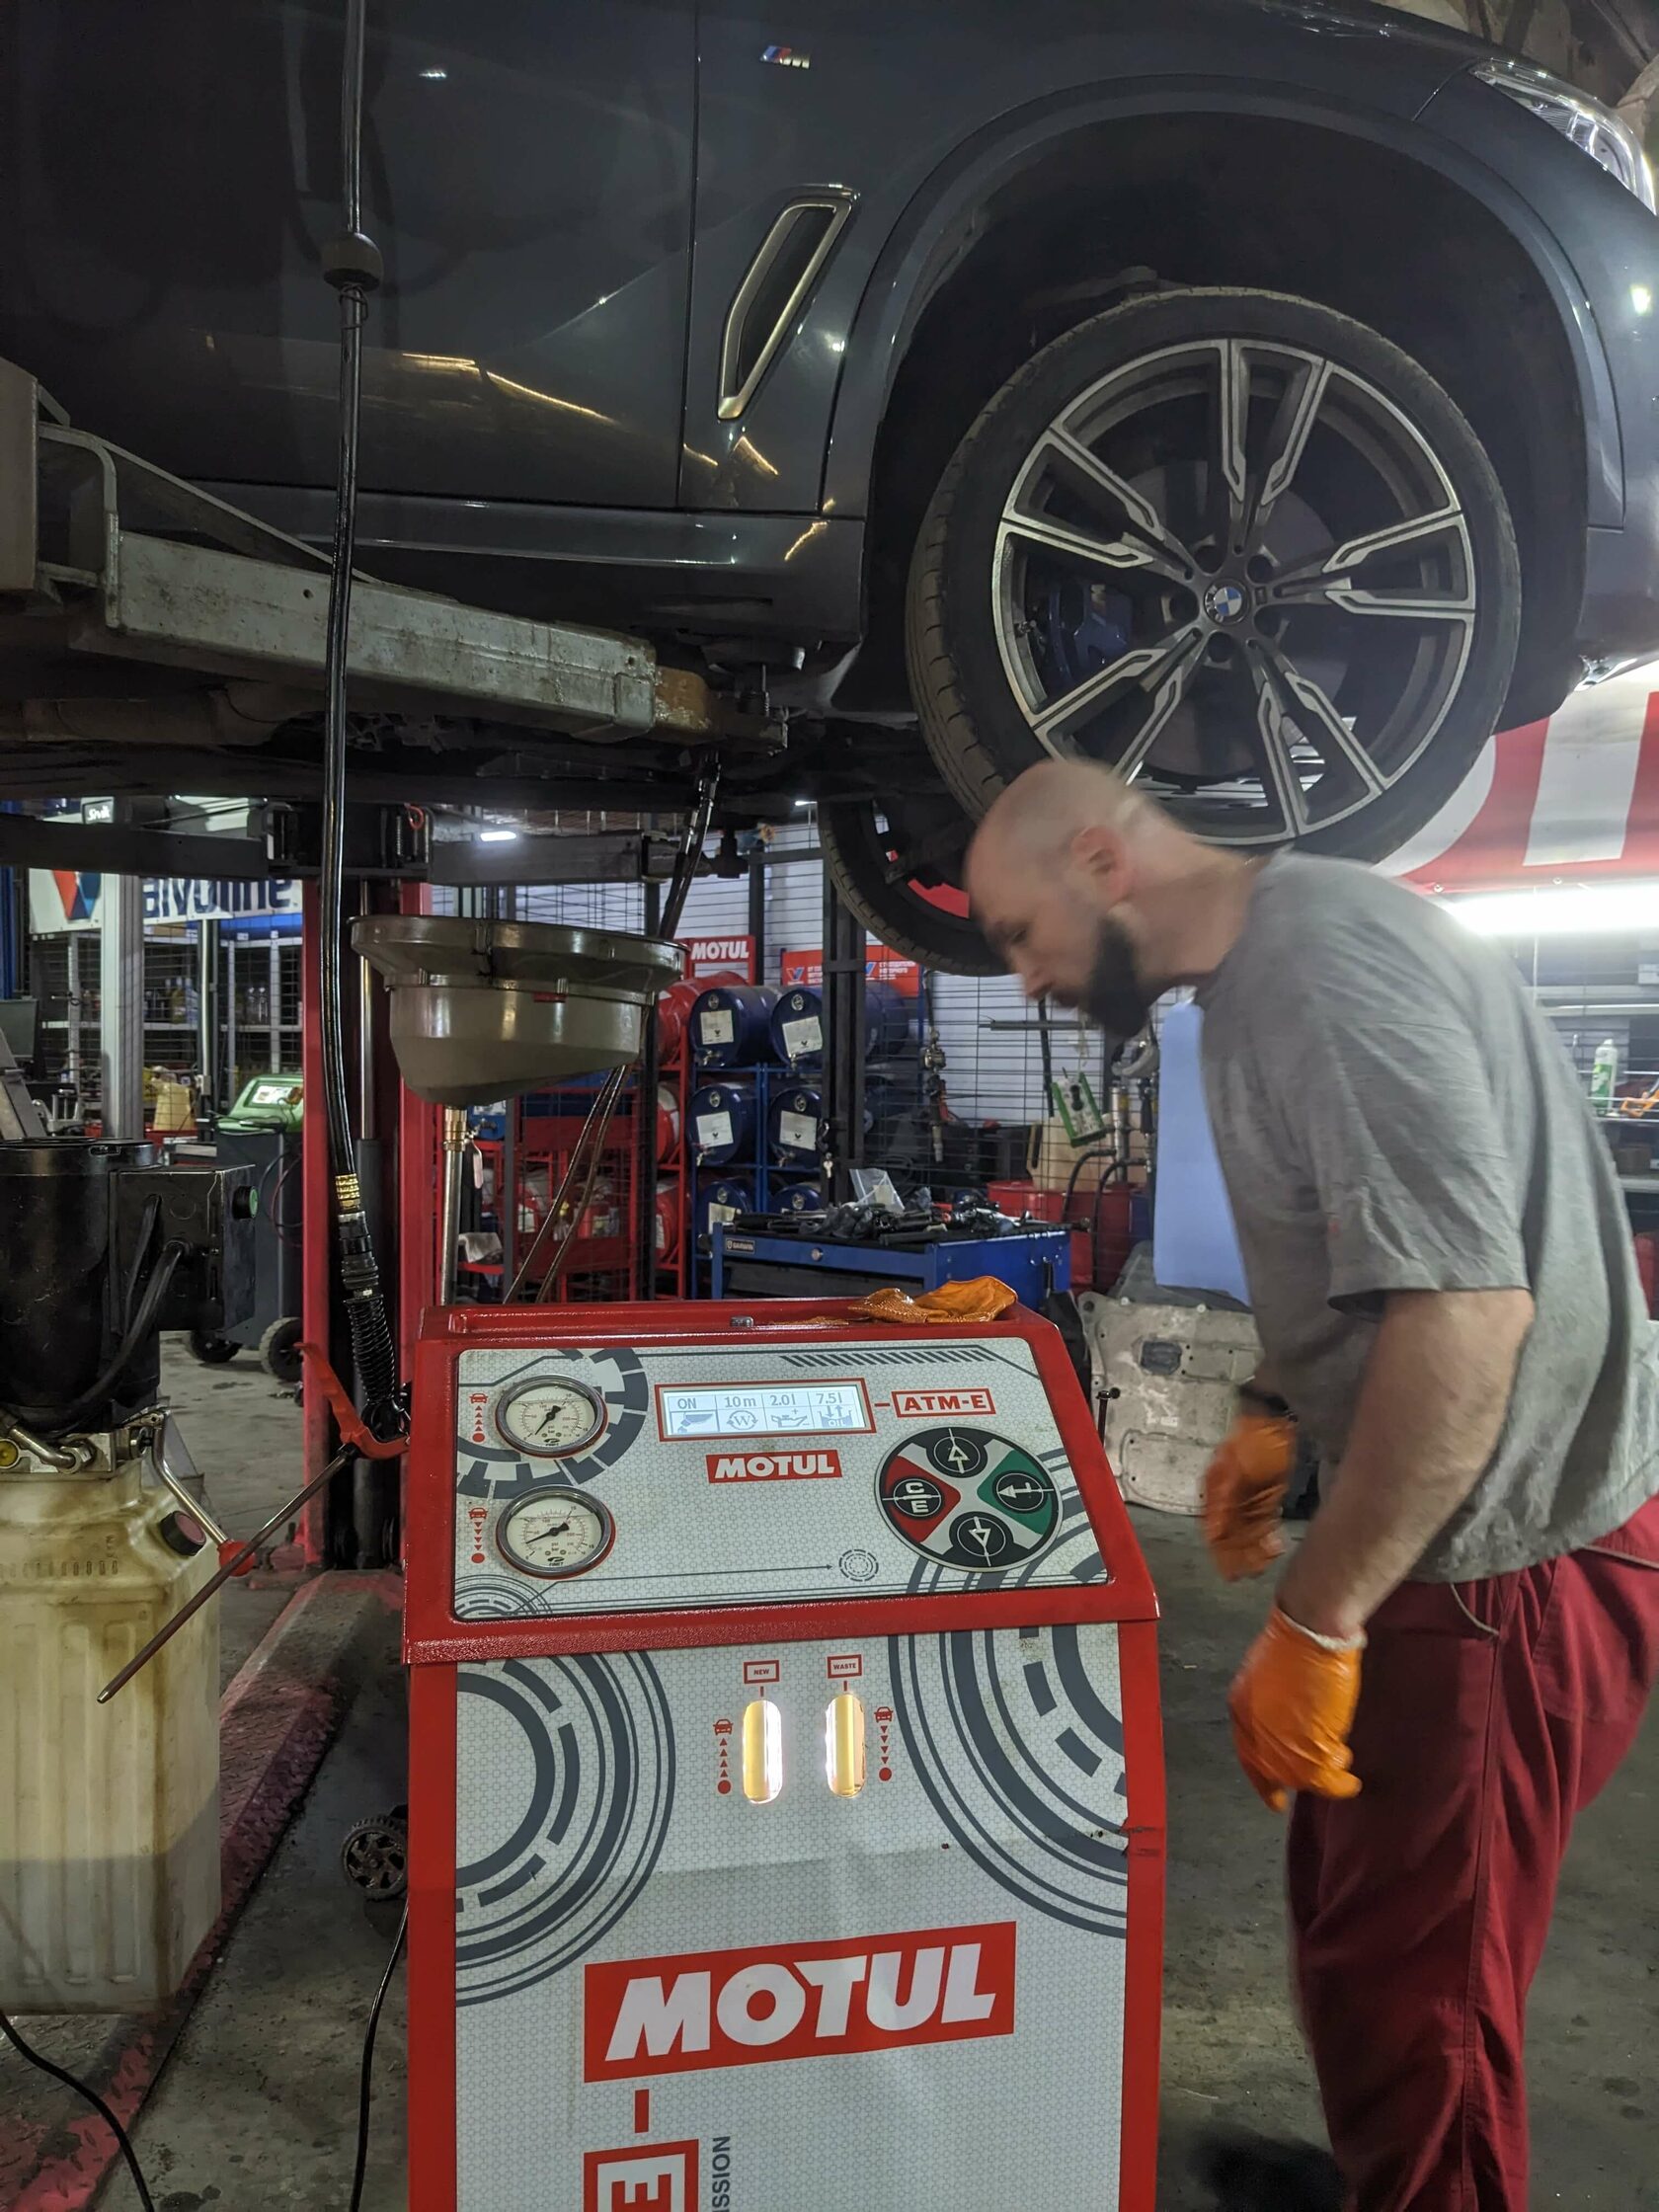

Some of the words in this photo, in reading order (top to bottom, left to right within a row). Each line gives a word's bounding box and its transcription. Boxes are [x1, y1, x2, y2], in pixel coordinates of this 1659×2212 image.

[690, 941, 750, 960] MOTUL
[677, 1397, 696, 1409] ON
[905, 1394, 987, 1411] ATM-E
[715, 1454, 835, 1479] MOTUL
[604, 1942, 996, 2062] MOTUL
